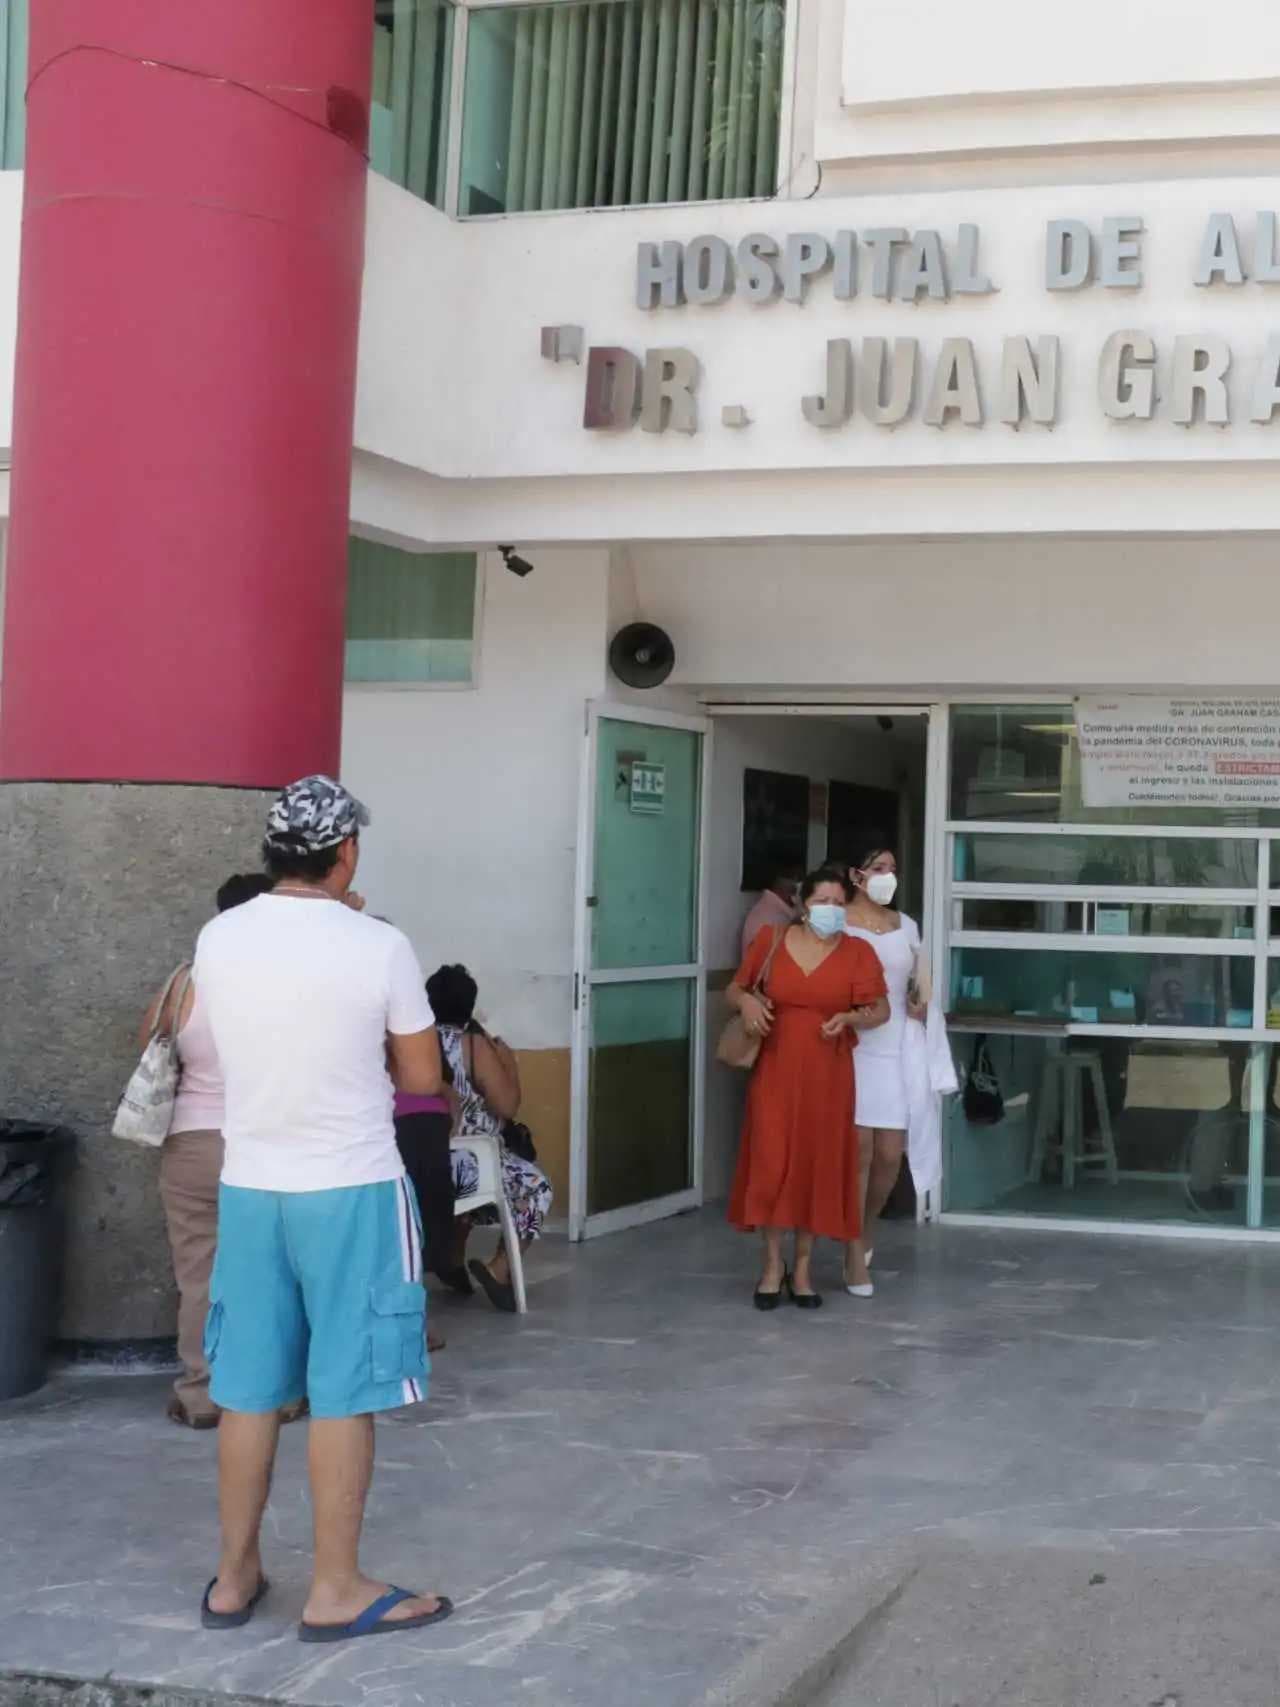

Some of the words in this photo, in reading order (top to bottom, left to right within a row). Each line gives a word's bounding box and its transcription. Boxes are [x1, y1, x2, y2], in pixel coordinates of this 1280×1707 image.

[636, 223, 998, 309] HOSPITAL
[1046, 216, 1143, 292] DE
[801, 335, 1060, 430] JUAN
[1083, 724, 1112, 733] Como
[1114, 725, 1135, 733] una
